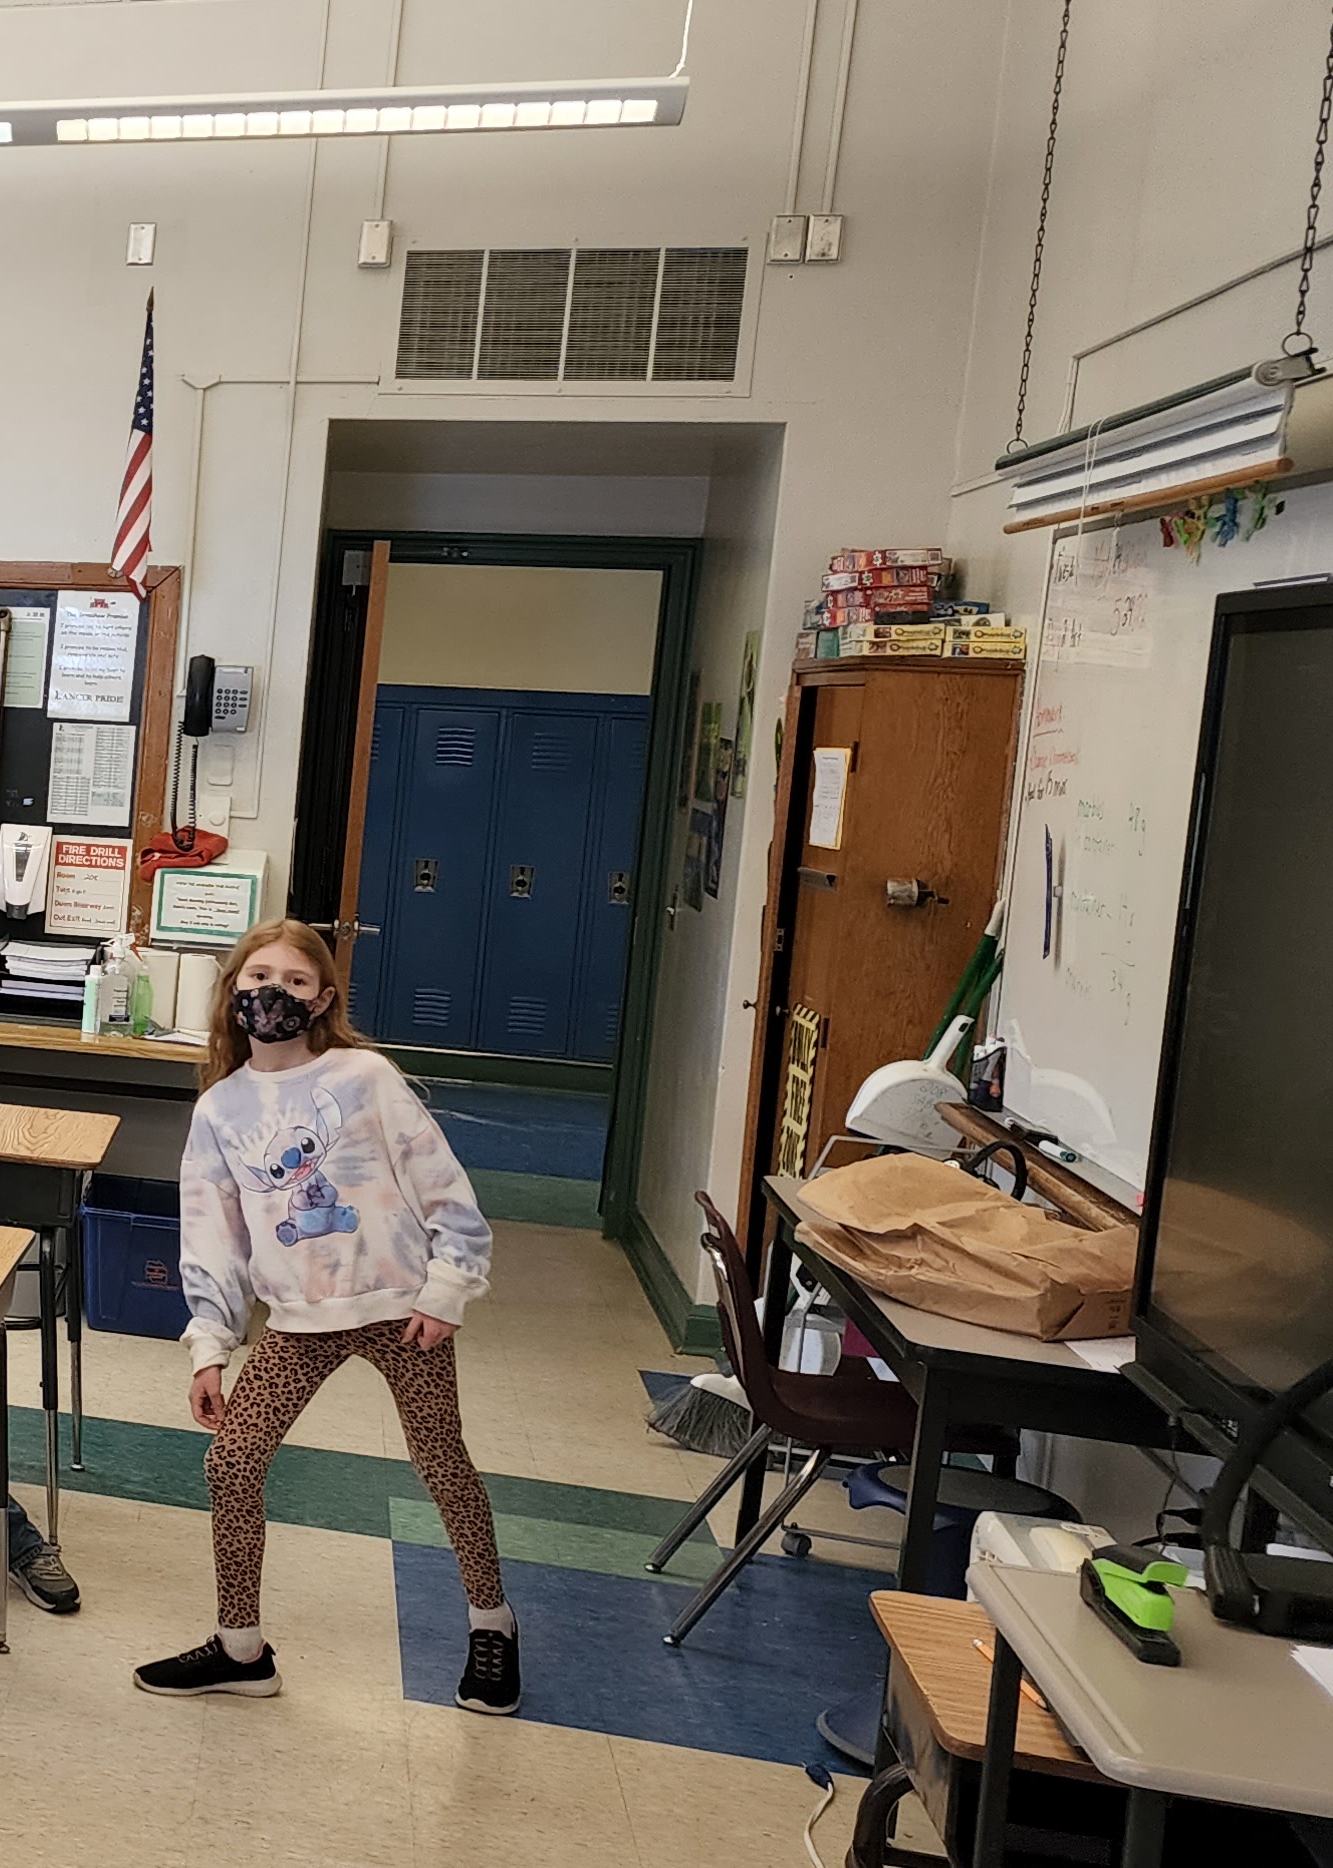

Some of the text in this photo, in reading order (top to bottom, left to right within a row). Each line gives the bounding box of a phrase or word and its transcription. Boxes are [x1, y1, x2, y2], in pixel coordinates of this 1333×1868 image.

[54, 690, 93, 704] LANCER
[62, 844, 122, 858] FIRE DRILL
[58, 853, 124, 868] DIRECTIONS
[56, 871, 76, 880] Room
